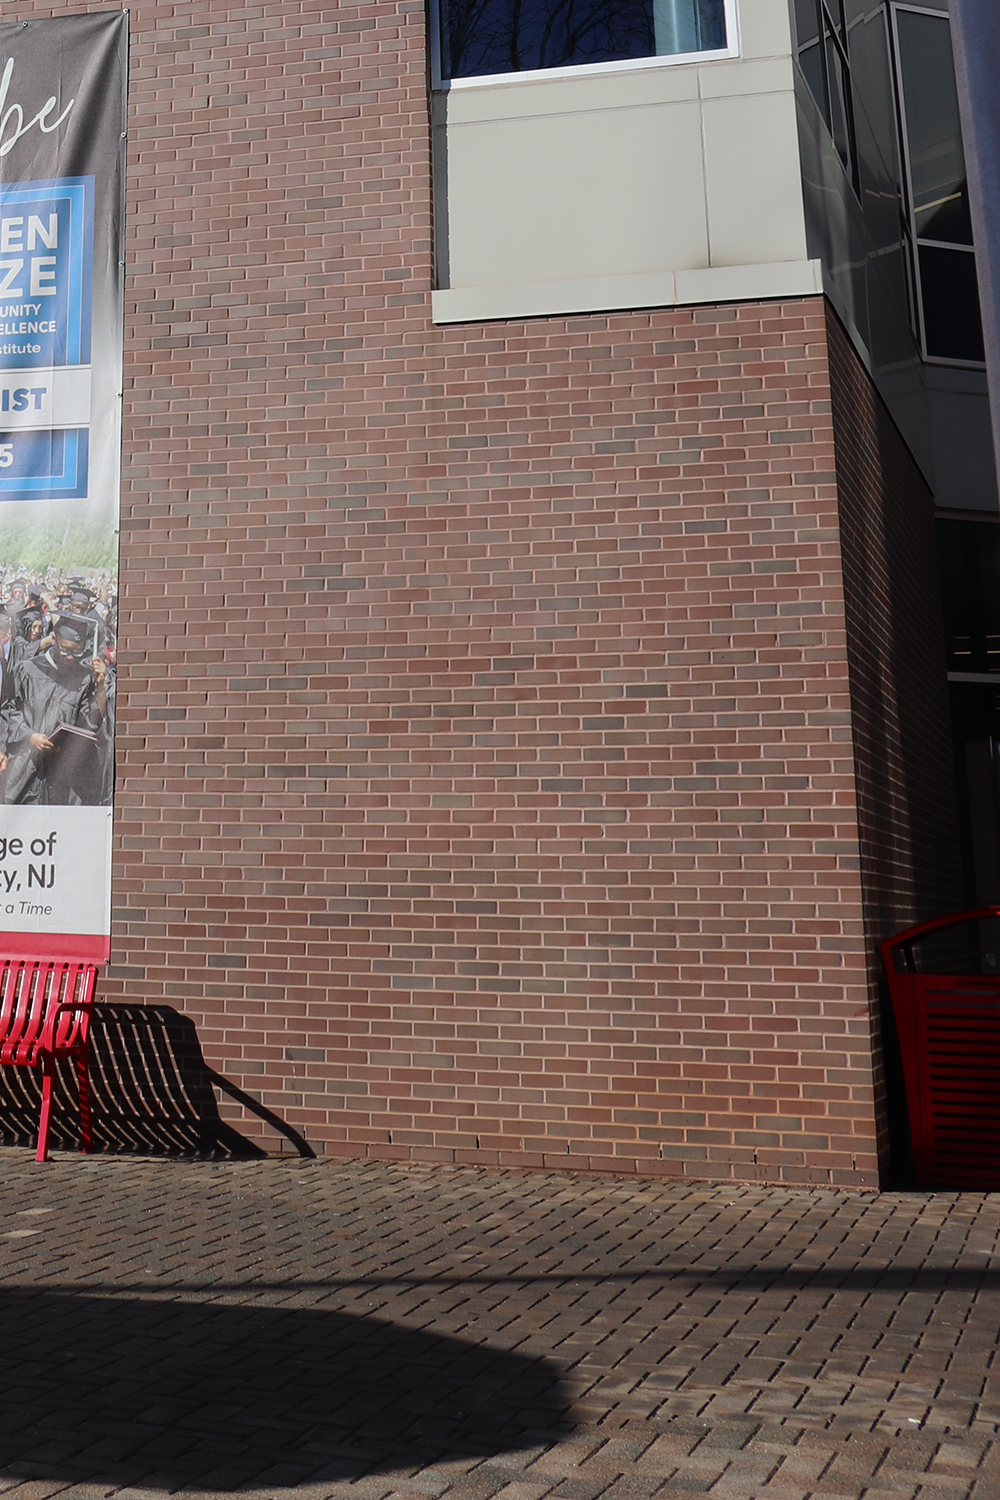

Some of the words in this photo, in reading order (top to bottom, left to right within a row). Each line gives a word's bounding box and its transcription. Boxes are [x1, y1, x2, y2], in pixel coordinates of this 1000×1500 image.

[30, 831, 57, 856] of
[28, 864, 55, 889] NJ
[5, 904, 14, 914] a
[19, 901, 53, 916] Time
